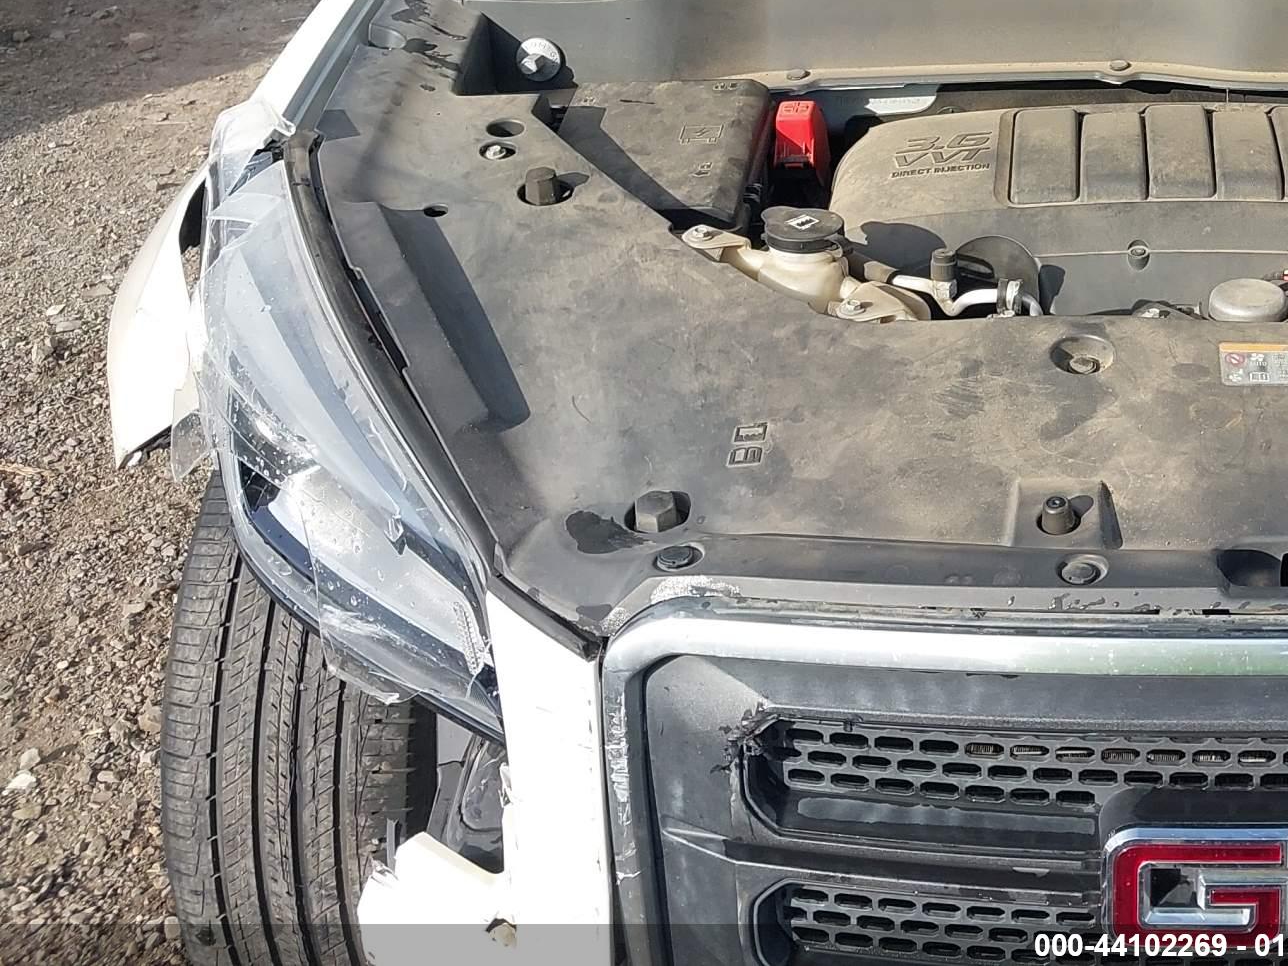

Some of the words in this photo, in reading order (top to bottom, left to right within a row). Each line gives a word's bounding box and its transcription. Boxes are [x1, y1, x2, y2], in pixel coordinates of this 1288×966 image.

[895, 130, 993, 155] 3.6
[893, 146, 991, 168] VVT
[891, 168, 933, 179] DIRECT
[934, 162, 990, 174] INJECTION
